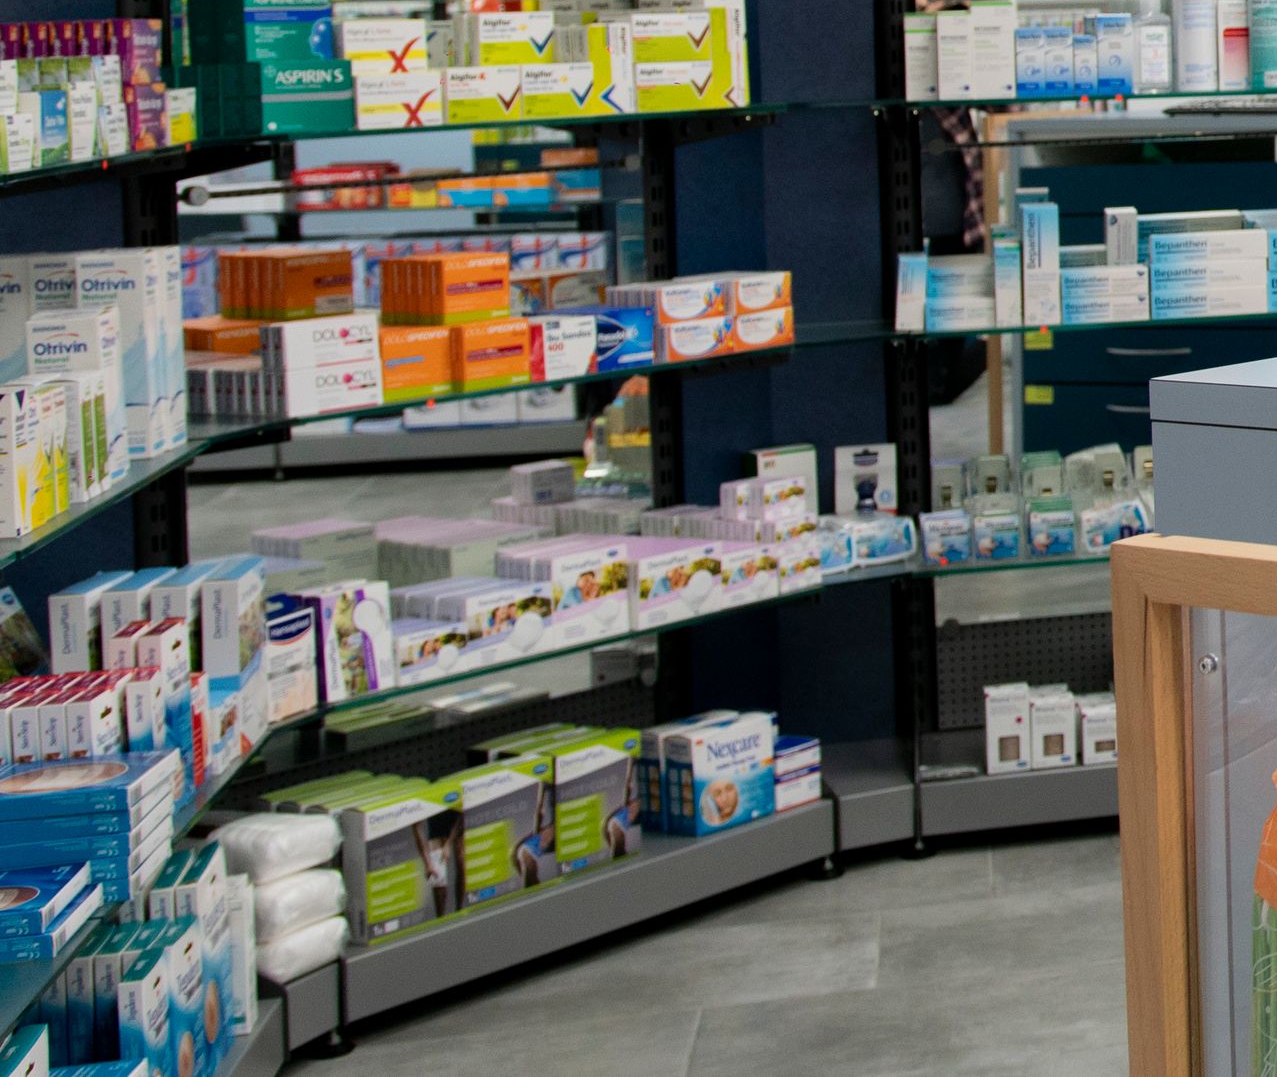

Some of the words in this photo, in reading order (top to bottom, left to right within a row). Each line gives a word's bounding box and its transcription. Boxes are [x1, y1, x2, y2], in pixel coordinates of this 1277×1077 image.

[275, 69, 331, 84] ASPIRIN
[1027, 212, 1036, 269] Bepanthen
[1154, 239, 1208, 251] Bepanthen
[1154, 266, 1207, 278] Bepanthen
[34, 278, 77, 292] Otriv
[80, 278, 136, 292] Otrivin
[1154, 294, 1207, 306] Bepanthen
[33, 341, 88, 356] Otrivin
[706, 732, 761, 759] Nexcare
